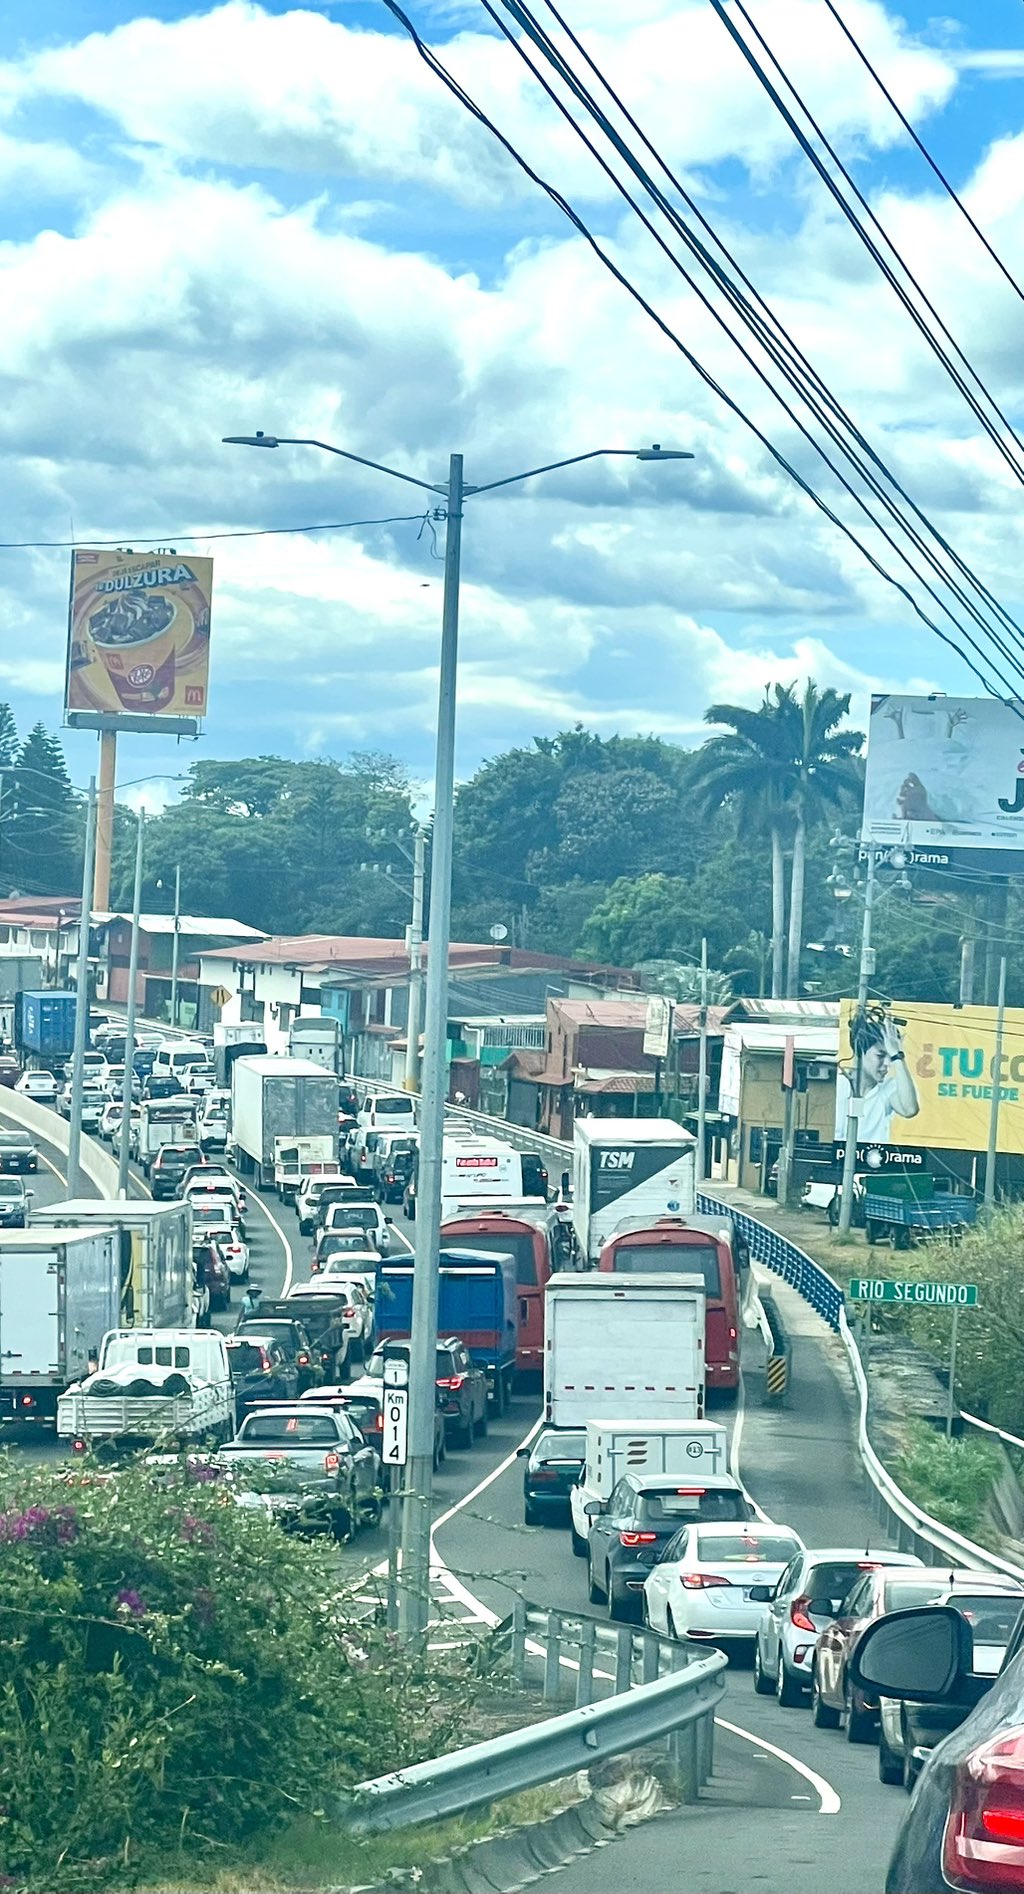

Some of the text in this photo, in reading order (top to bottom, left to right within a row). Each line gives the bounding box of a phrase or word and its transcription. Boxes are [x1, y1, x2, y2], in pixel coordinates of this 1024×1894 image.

[105, 563, 192, 592] DULZURA
[938, 1083, 958, 1097] SE
[600, 1151, 636, 1169] TSM
[858, 1280, 968, 1304] RIO SEGUNDO
[393, 1371, 398, 1383] 1
[387, 1392, 404, 1404] Km
